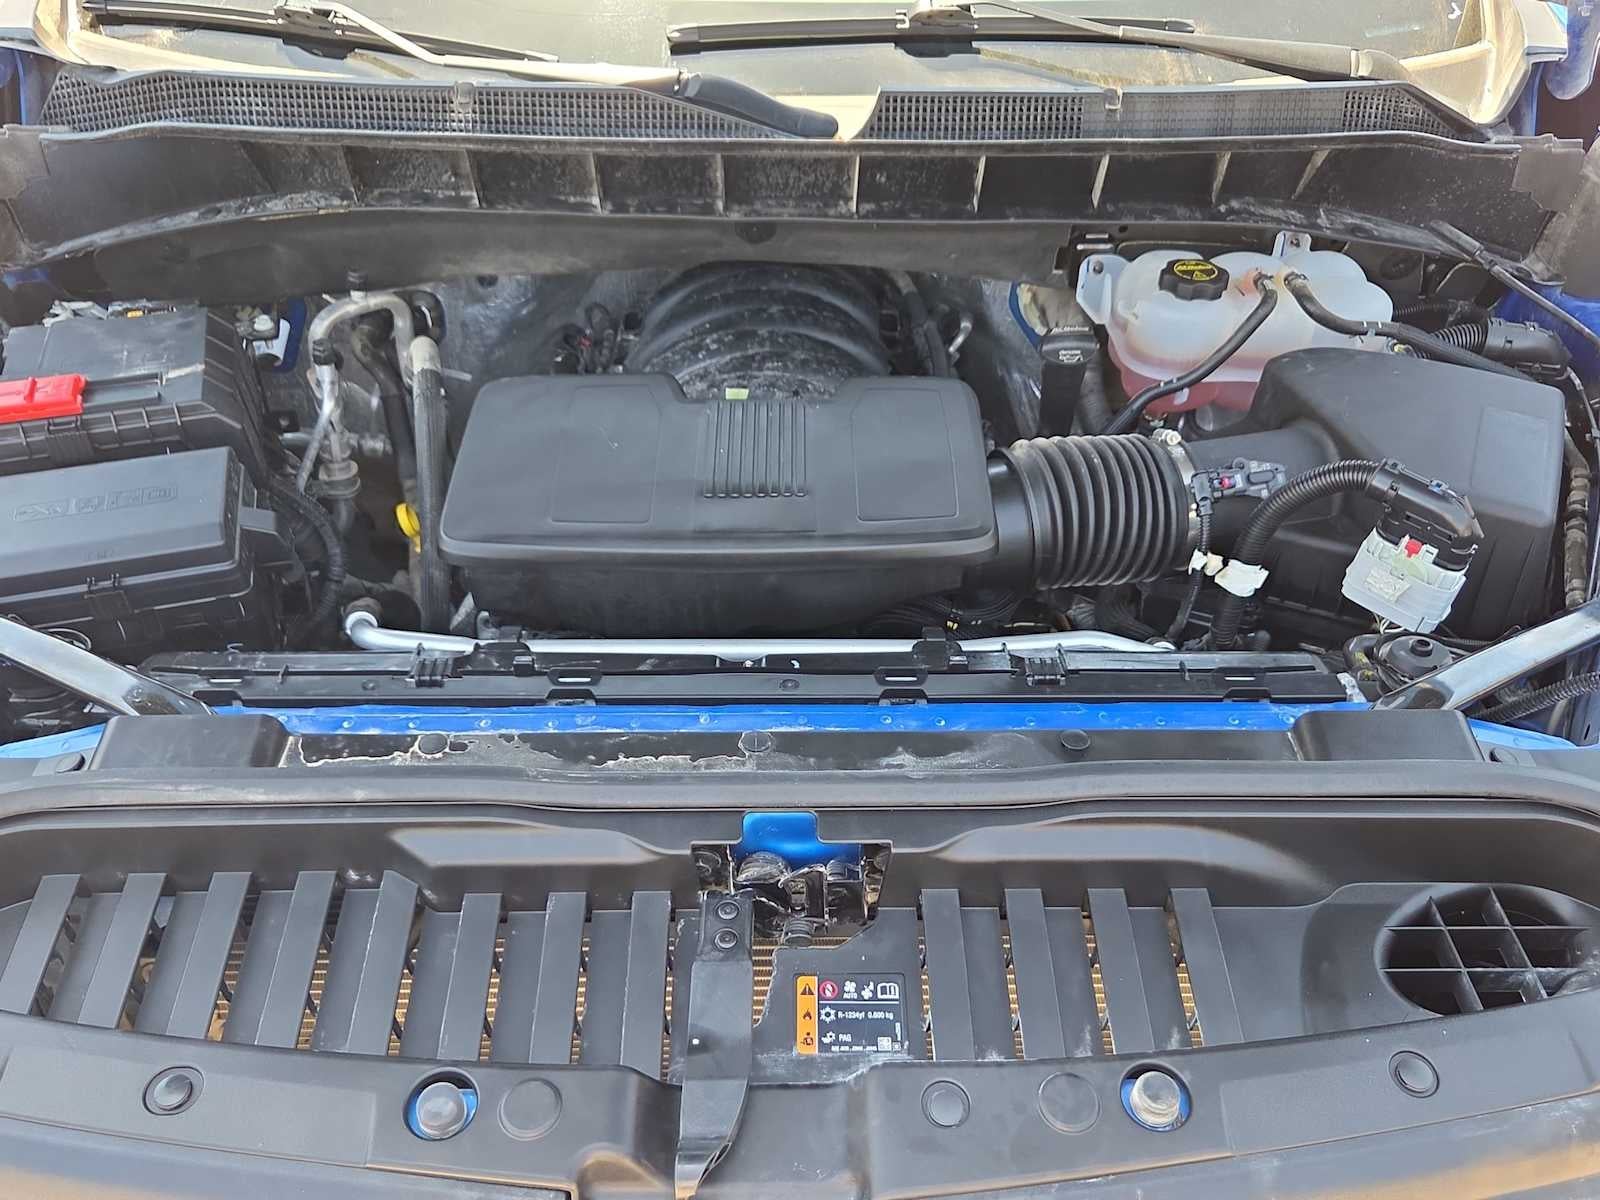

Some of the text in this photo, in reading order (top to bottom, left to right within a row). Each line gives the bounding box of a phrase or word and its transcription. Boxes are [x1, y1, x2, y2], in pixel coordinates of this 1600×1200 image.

[838, 1011, 865, 1020] R-1234yf
[885, 1011, 893, 1020] kg
[839, 1033, 852, 1042] PAG
